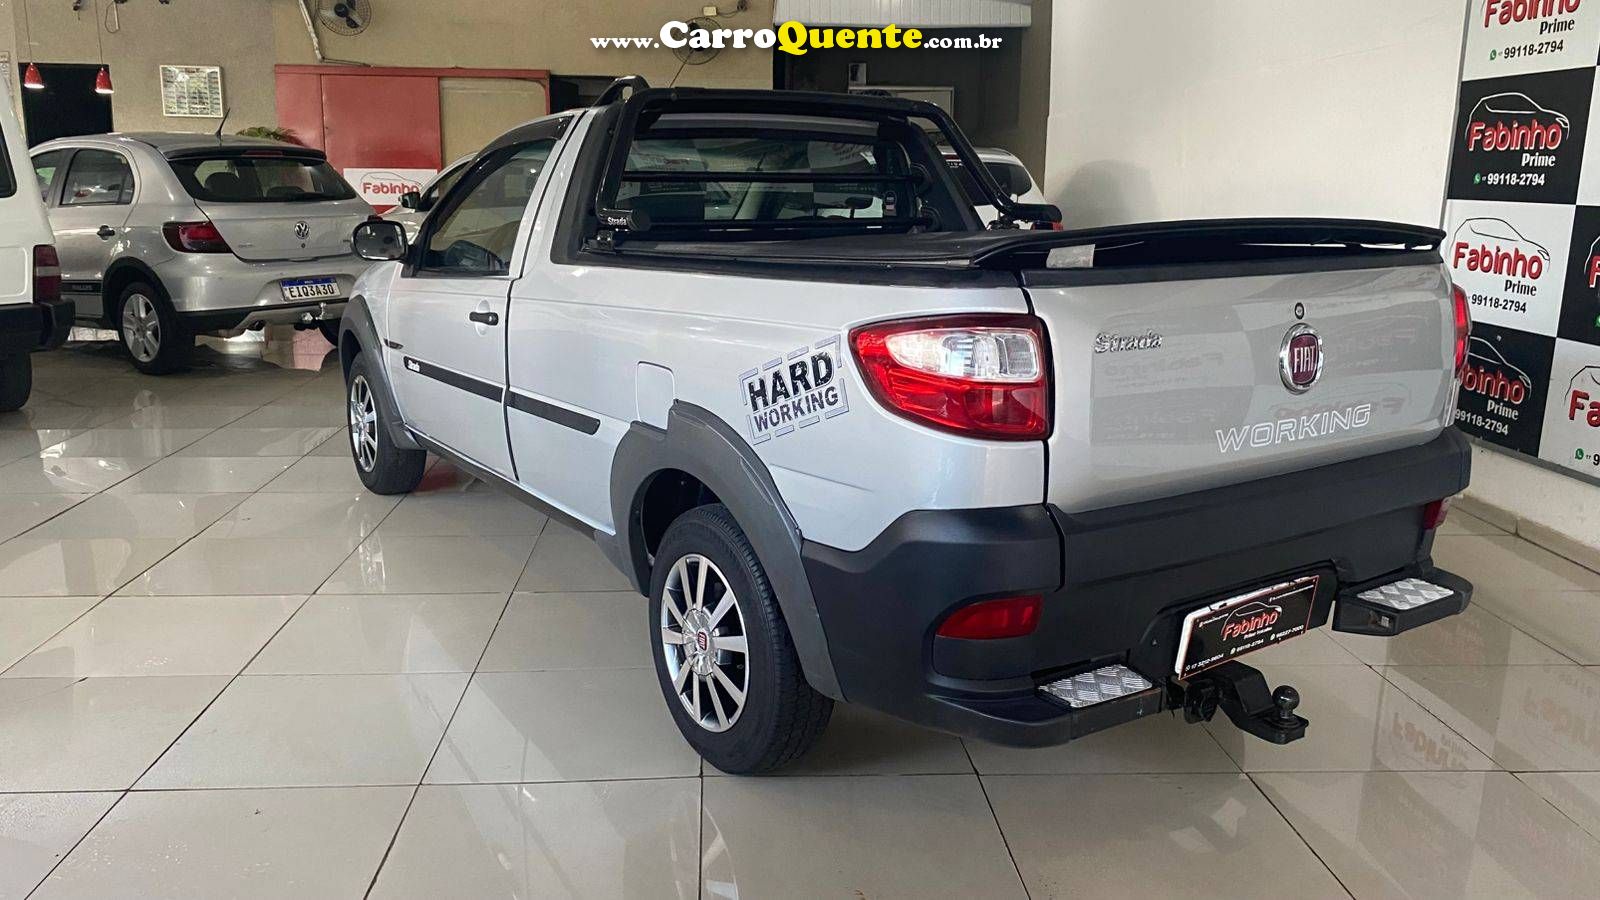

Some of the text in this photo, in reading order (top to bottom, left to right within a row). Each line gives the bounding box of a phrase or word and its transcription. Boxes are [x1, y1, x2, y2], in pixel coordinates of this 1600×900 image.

[1540, 18, 1575, 35] Prime
[1504, 40, 1564, 59] 99118-2794
[1468, 119, 1562, 151] Fabinho
[1521, 152, 1556, 167] Prime
[363, 182, 419, 194] Fabinho
[1487, 173, 1545, 186] 99118-2794
[1453, 241, 1543, 280] Fabinho
[1504, 279, 1537, 297] Prime
[1471, 294, 1527, 313] 99118-2794
[1094, 330, 1163, 353] Strada
[1294, 345, 1315, 373] FIAT
[748, 352, 833, 412] HARD
[1459, 363, 1525, 405] binho
[753, 386, 839, 432] WORKING
[1487, 399, 1519, 421] Prime
[1215, 403, 1371, 453] WORKING
[1455, 408, 1509, 436] 99118-2794
[1223, 610, 1279, 641] Fabinho
